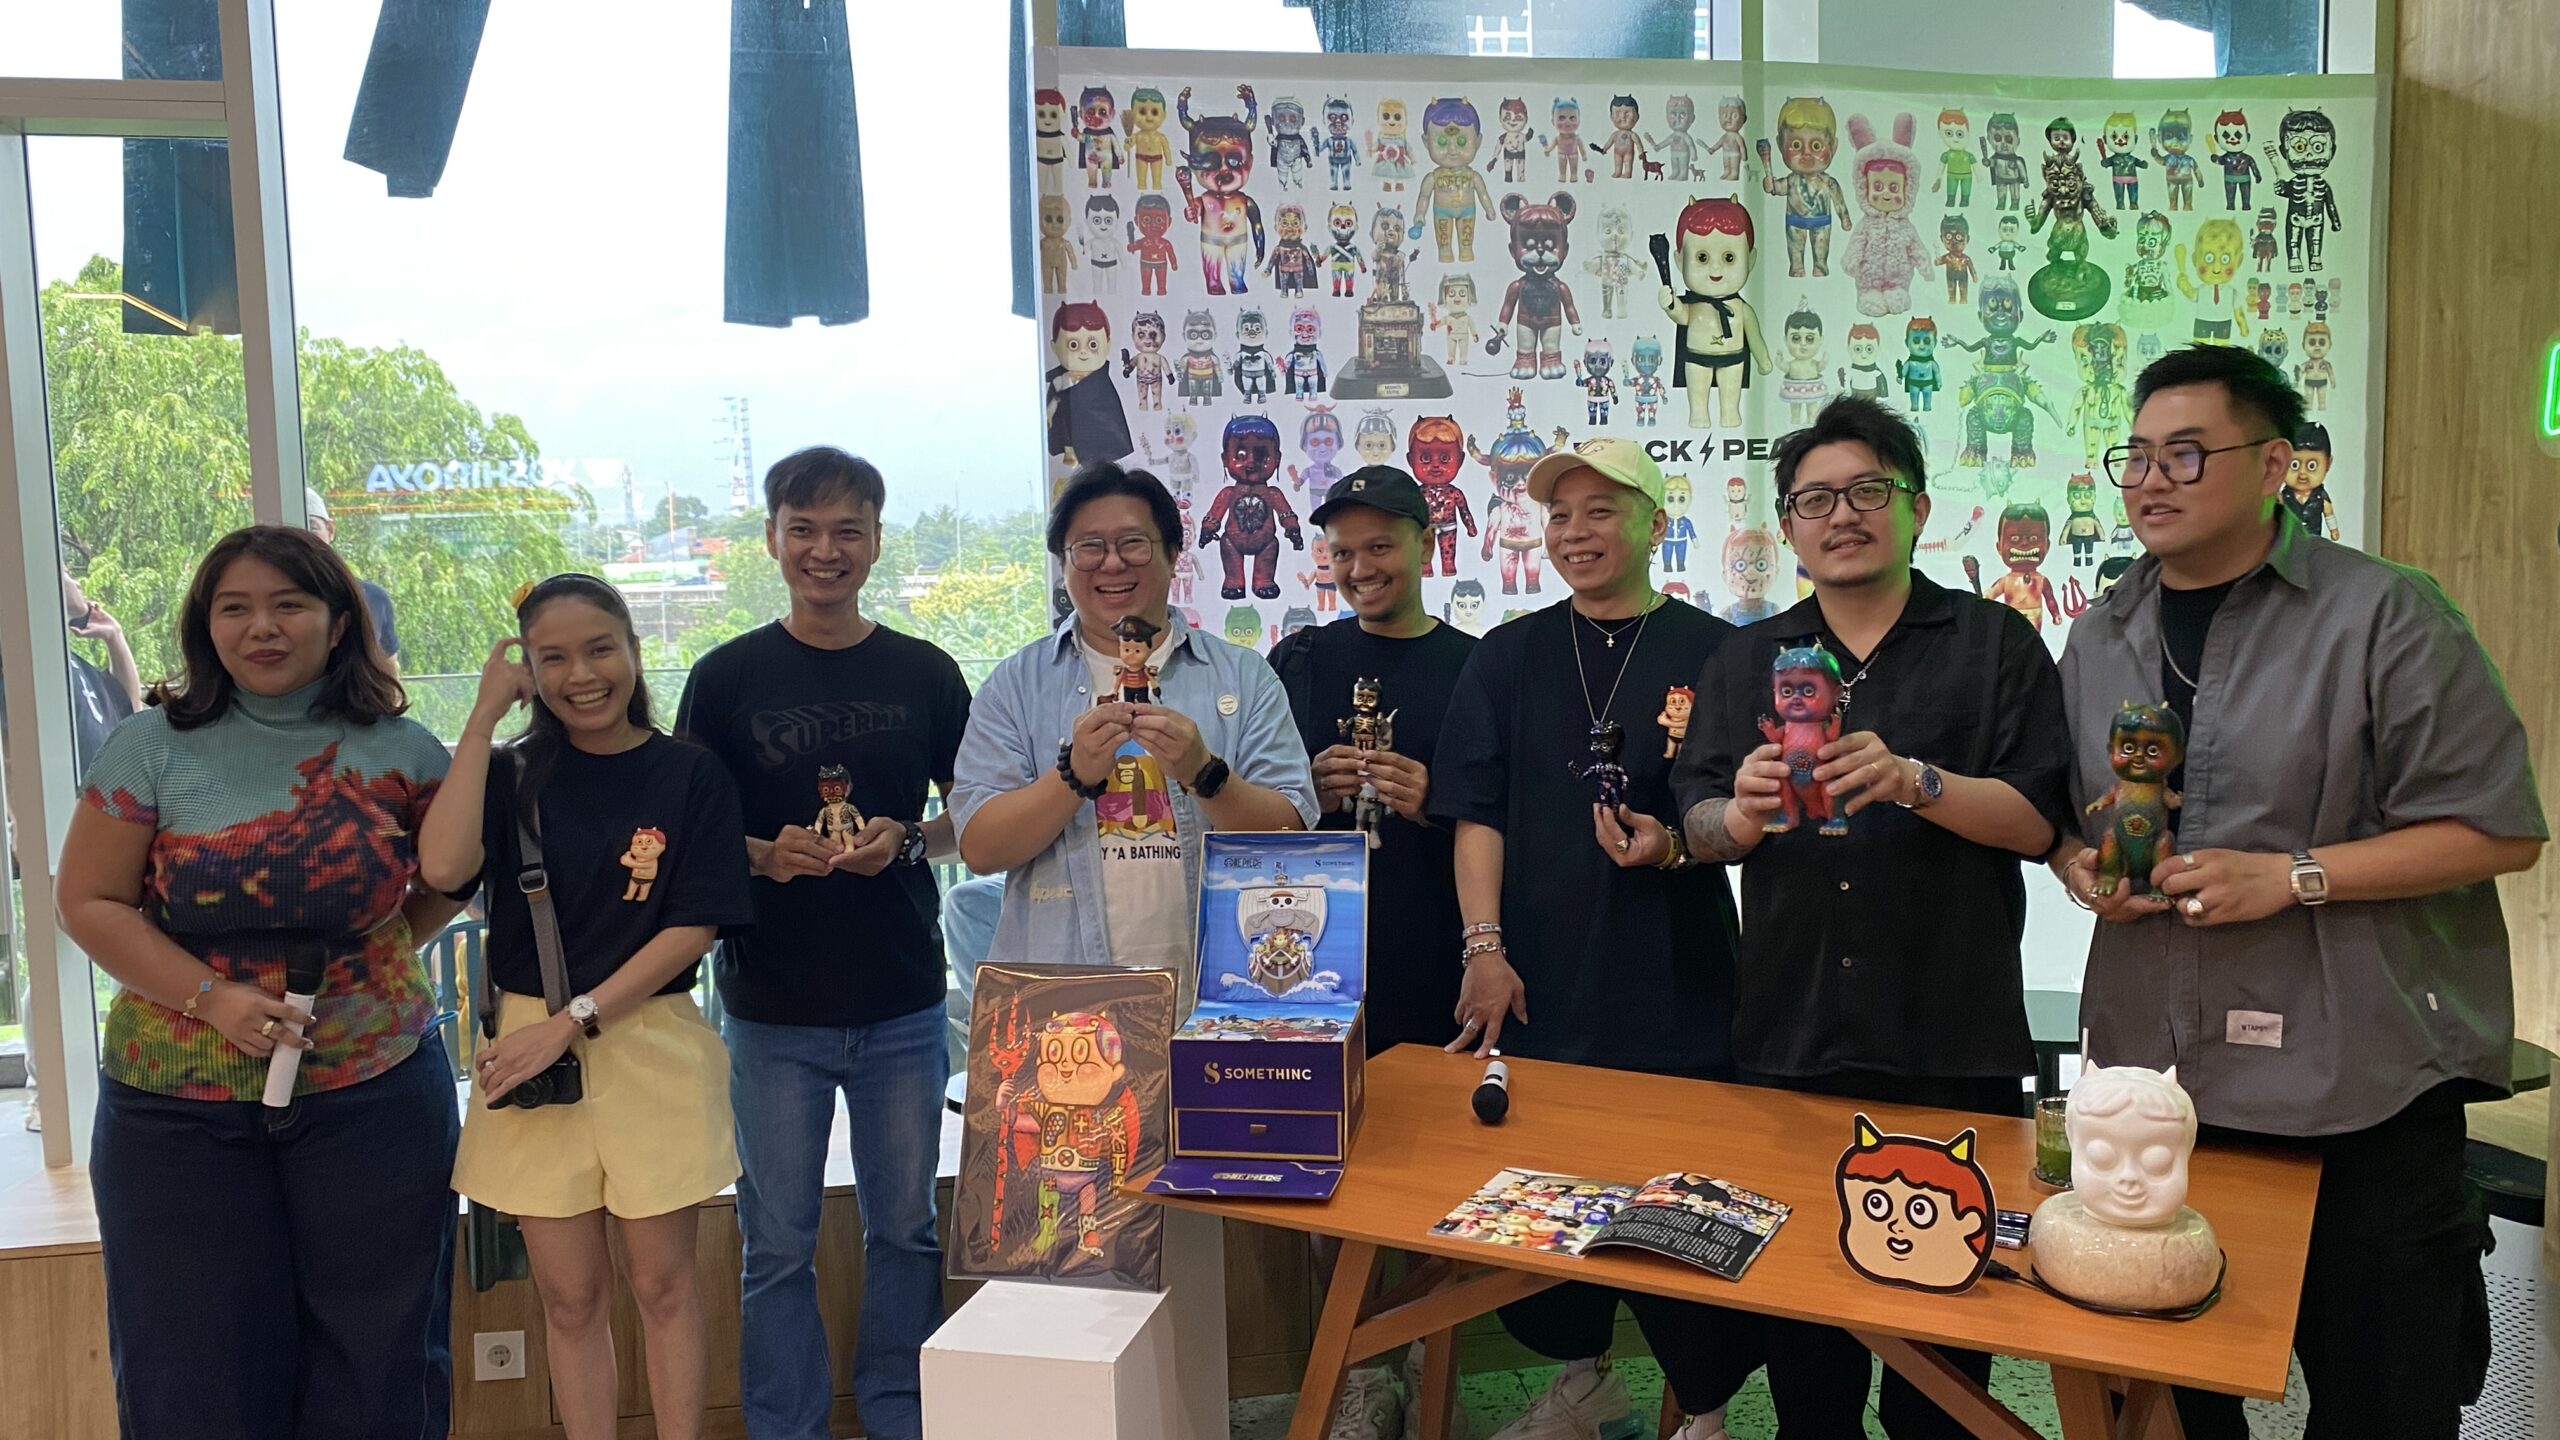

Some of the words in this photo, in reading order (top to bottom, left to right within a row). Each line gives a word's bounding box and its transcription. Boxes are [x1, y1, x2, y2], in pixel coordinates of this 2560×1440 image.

[1723, 438, 1782, 461] PEA
[751, 702, 911, 775] SUPERMA
[1130, 845, 1181, 860] BATHING
[1224, 1068, 1312, 1081] SOMETHINC
